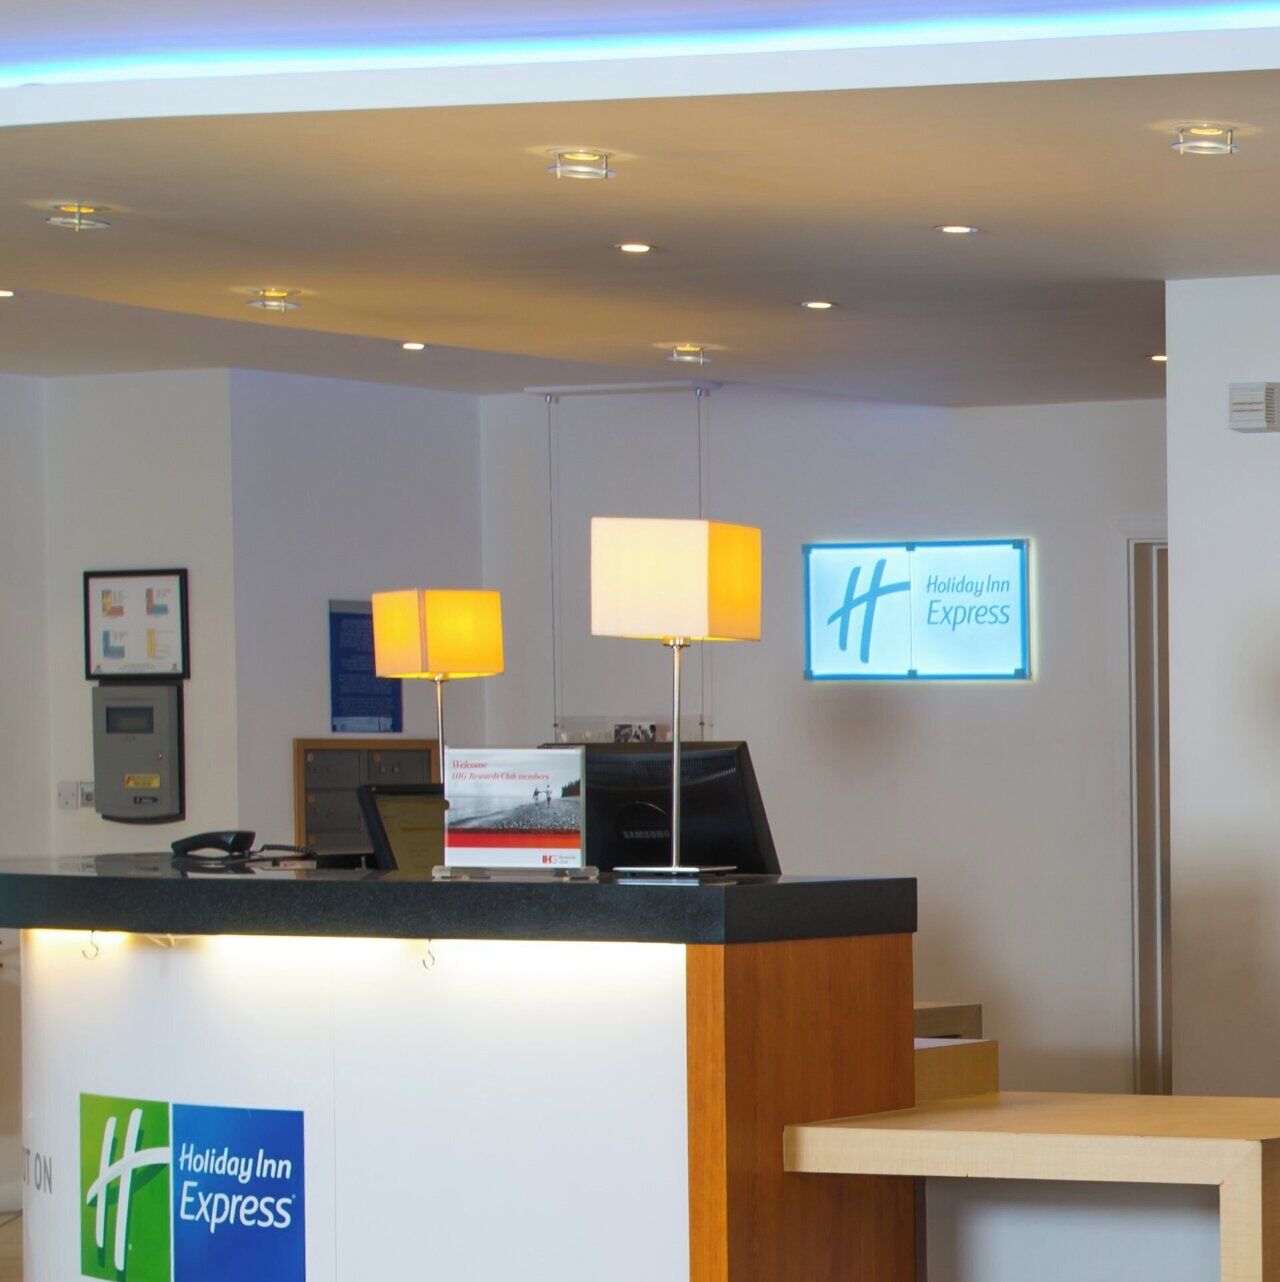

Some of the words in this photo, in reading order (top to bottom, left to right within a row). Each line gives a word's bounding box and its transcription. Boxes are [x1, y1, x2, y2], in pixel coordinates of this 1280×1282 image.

[926, 575, 983, 598] Holiday
[985, 574, 1011, 593] Inn
[926, 599, 1011, 632] Express
[452, 759, 488, 769] Welcome
[452, 772, 467, 780] IHG
[469, 772, 500, 780] Rewards
[500, 772, 517, 780] Club
[517, 772, 550, 781] members
[178, 1142, 252, 1184] Holiday
[256, 1148, 292, 1180] Inn
[179, 1180, 293, 1235] Express
